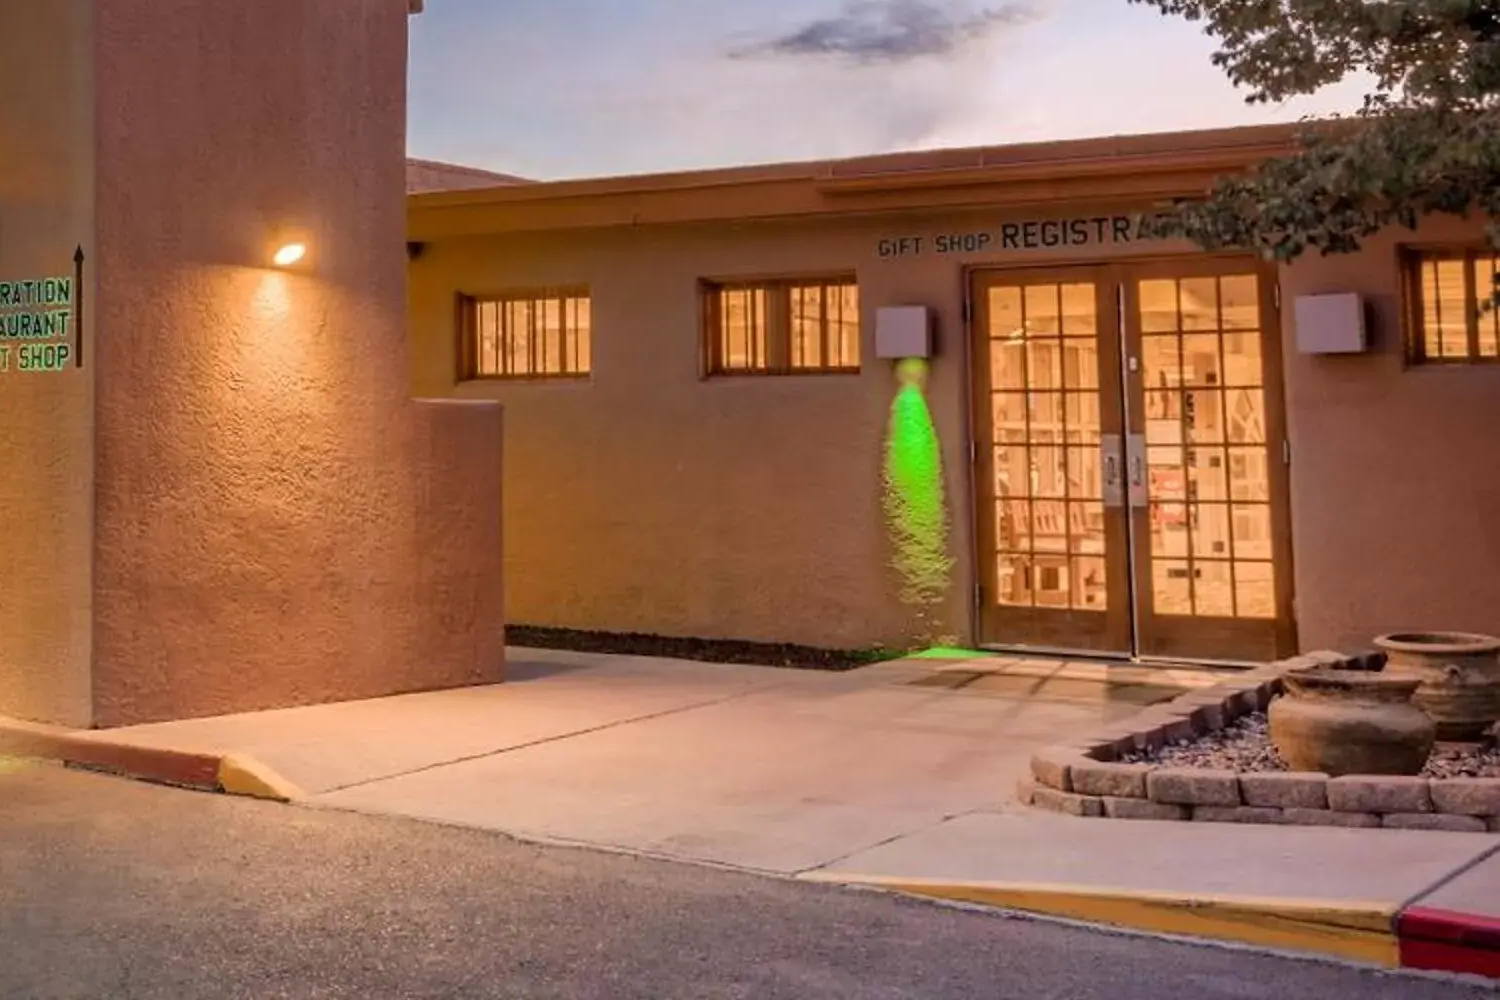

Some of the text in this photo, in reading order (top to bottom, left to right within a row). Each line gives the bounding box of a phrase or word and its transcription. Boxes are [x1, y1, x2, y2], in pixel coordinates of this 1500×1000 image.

[878, 236, 922, 257] GIFT
[934, 232, 990, 253] SHOP
[19, 344, 69, 369] SHOP
